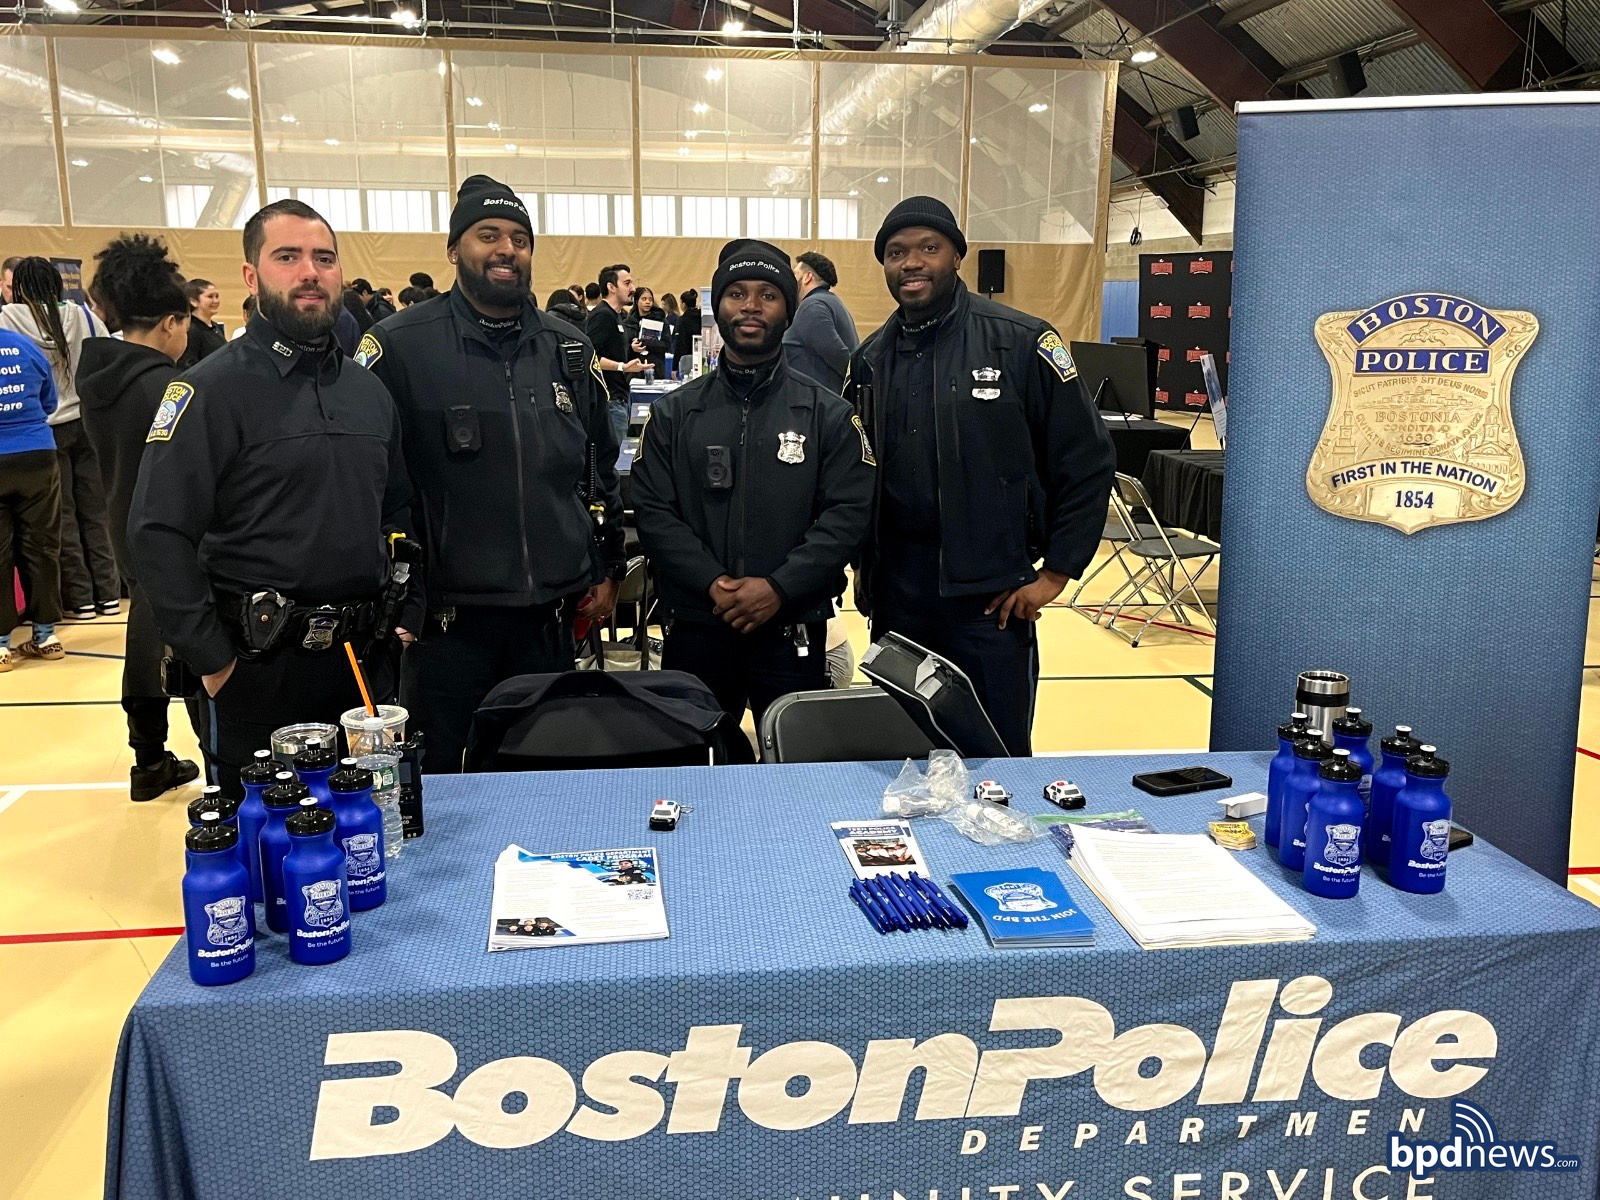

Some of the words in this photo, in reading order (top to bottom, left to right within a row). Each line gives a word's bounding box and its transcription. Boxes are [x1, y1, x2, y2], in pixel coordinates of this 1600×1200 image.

[729, 261, 756, 271] Boston
[757, 261, 780, 274] Police
[1356, 297, 1500, 340] BOSTON
[1360, 352, 1484, 371] POLICE
[0, 364, 22, 376] out
[1353, 384, 1376, 397] SICUT
[1377, 376, 1418, 389] PATRIBUS
[1437, 377, 1462, 389] DEUS
[1463, 383, 1489, 399] NOBIS
[1375, 410, 1462, 423] BOSTONIA
[1383, 424, 1436, 433] CONDITA
[1398, 433, 1433, 443] 1630
[1331, 464, 1377, 488] FIRST
[1380, 461, 1397, 475] IN
[1401, 461, 1433, 475] THE
[1436, 463, 1498, 493] NATION
[1395, 490, 1434, 508] 1854
[606, 853, 652, 861] PROGRAM
[992, 915, 1020, 923] BPD
[1022, 915, 1051, 923] THE
[1050, 908, 1078, 920] JOIN
[316, 939, 328, 947] the
[328, 936, 344, 945] future
[220, 959, 232, 967] the
[232, 953, 249, 964] future
[960, 1107, 1426, 1155] DEPARTMEN
[1123, 1165, 1435, 1200] SERVICE
